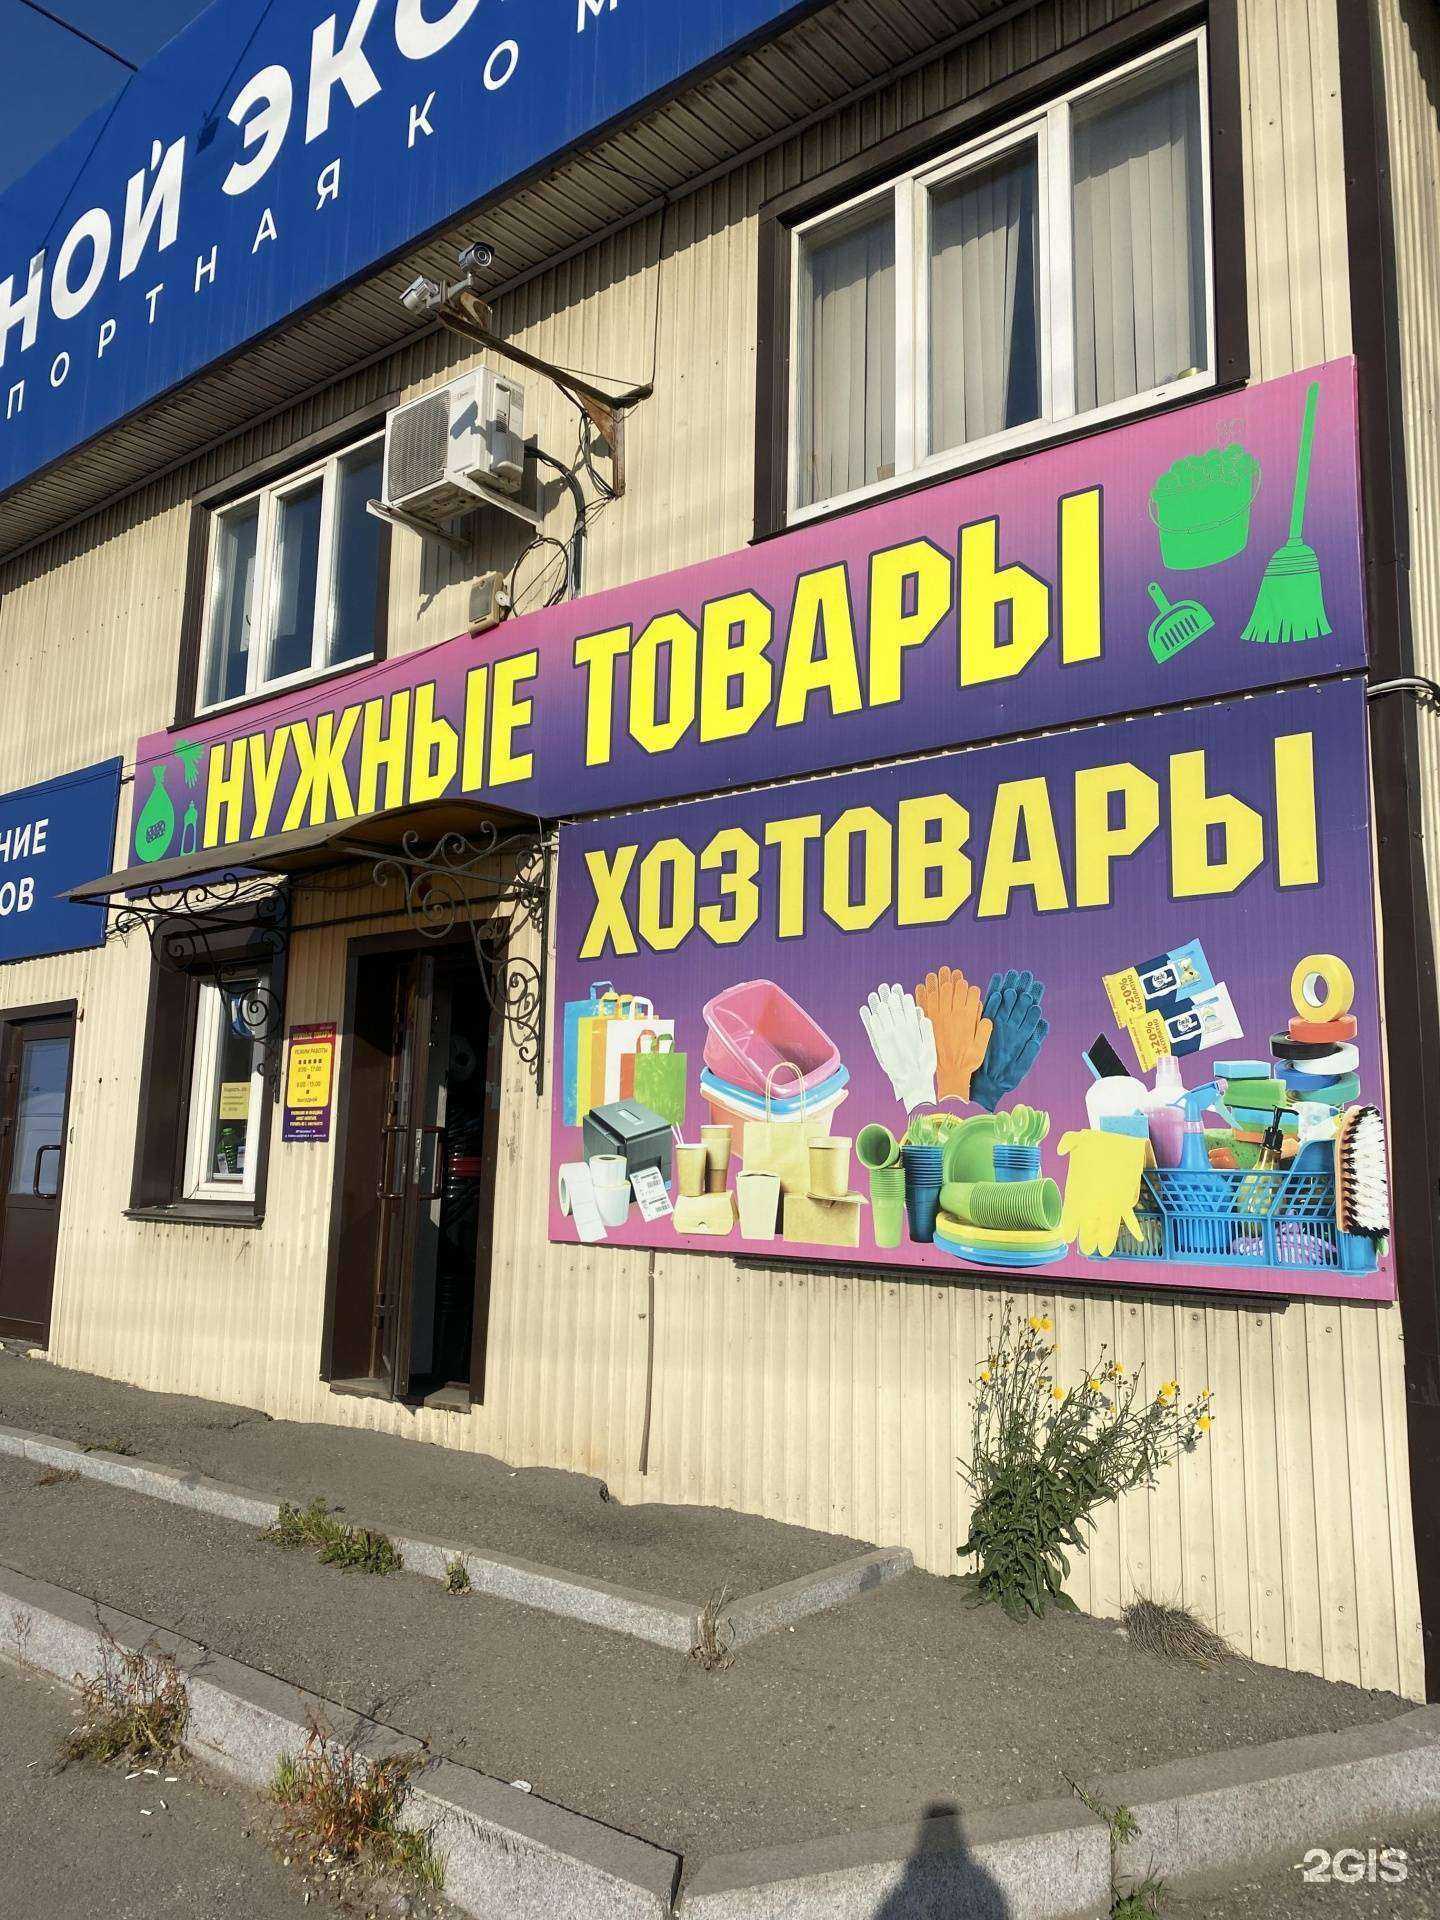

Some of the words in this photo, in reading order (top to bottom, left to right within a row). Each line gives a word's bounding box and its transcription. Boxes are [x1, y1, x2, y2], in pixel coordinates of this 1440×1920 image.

[0, 134, 186, 369] НОЙ
[6, 157, 341, 420] ПОРТНАЯ
[202, 650, 539, 849] НУЖНЫЕ
[573, 485, 1103, 768] ТОВАРЫ
[577, 731, 1321, 960] ХОЗТОВАРЫ
[1119, 977, 1137, 1013] +20%
[1146, 1020, 1163, 1056] +20%
